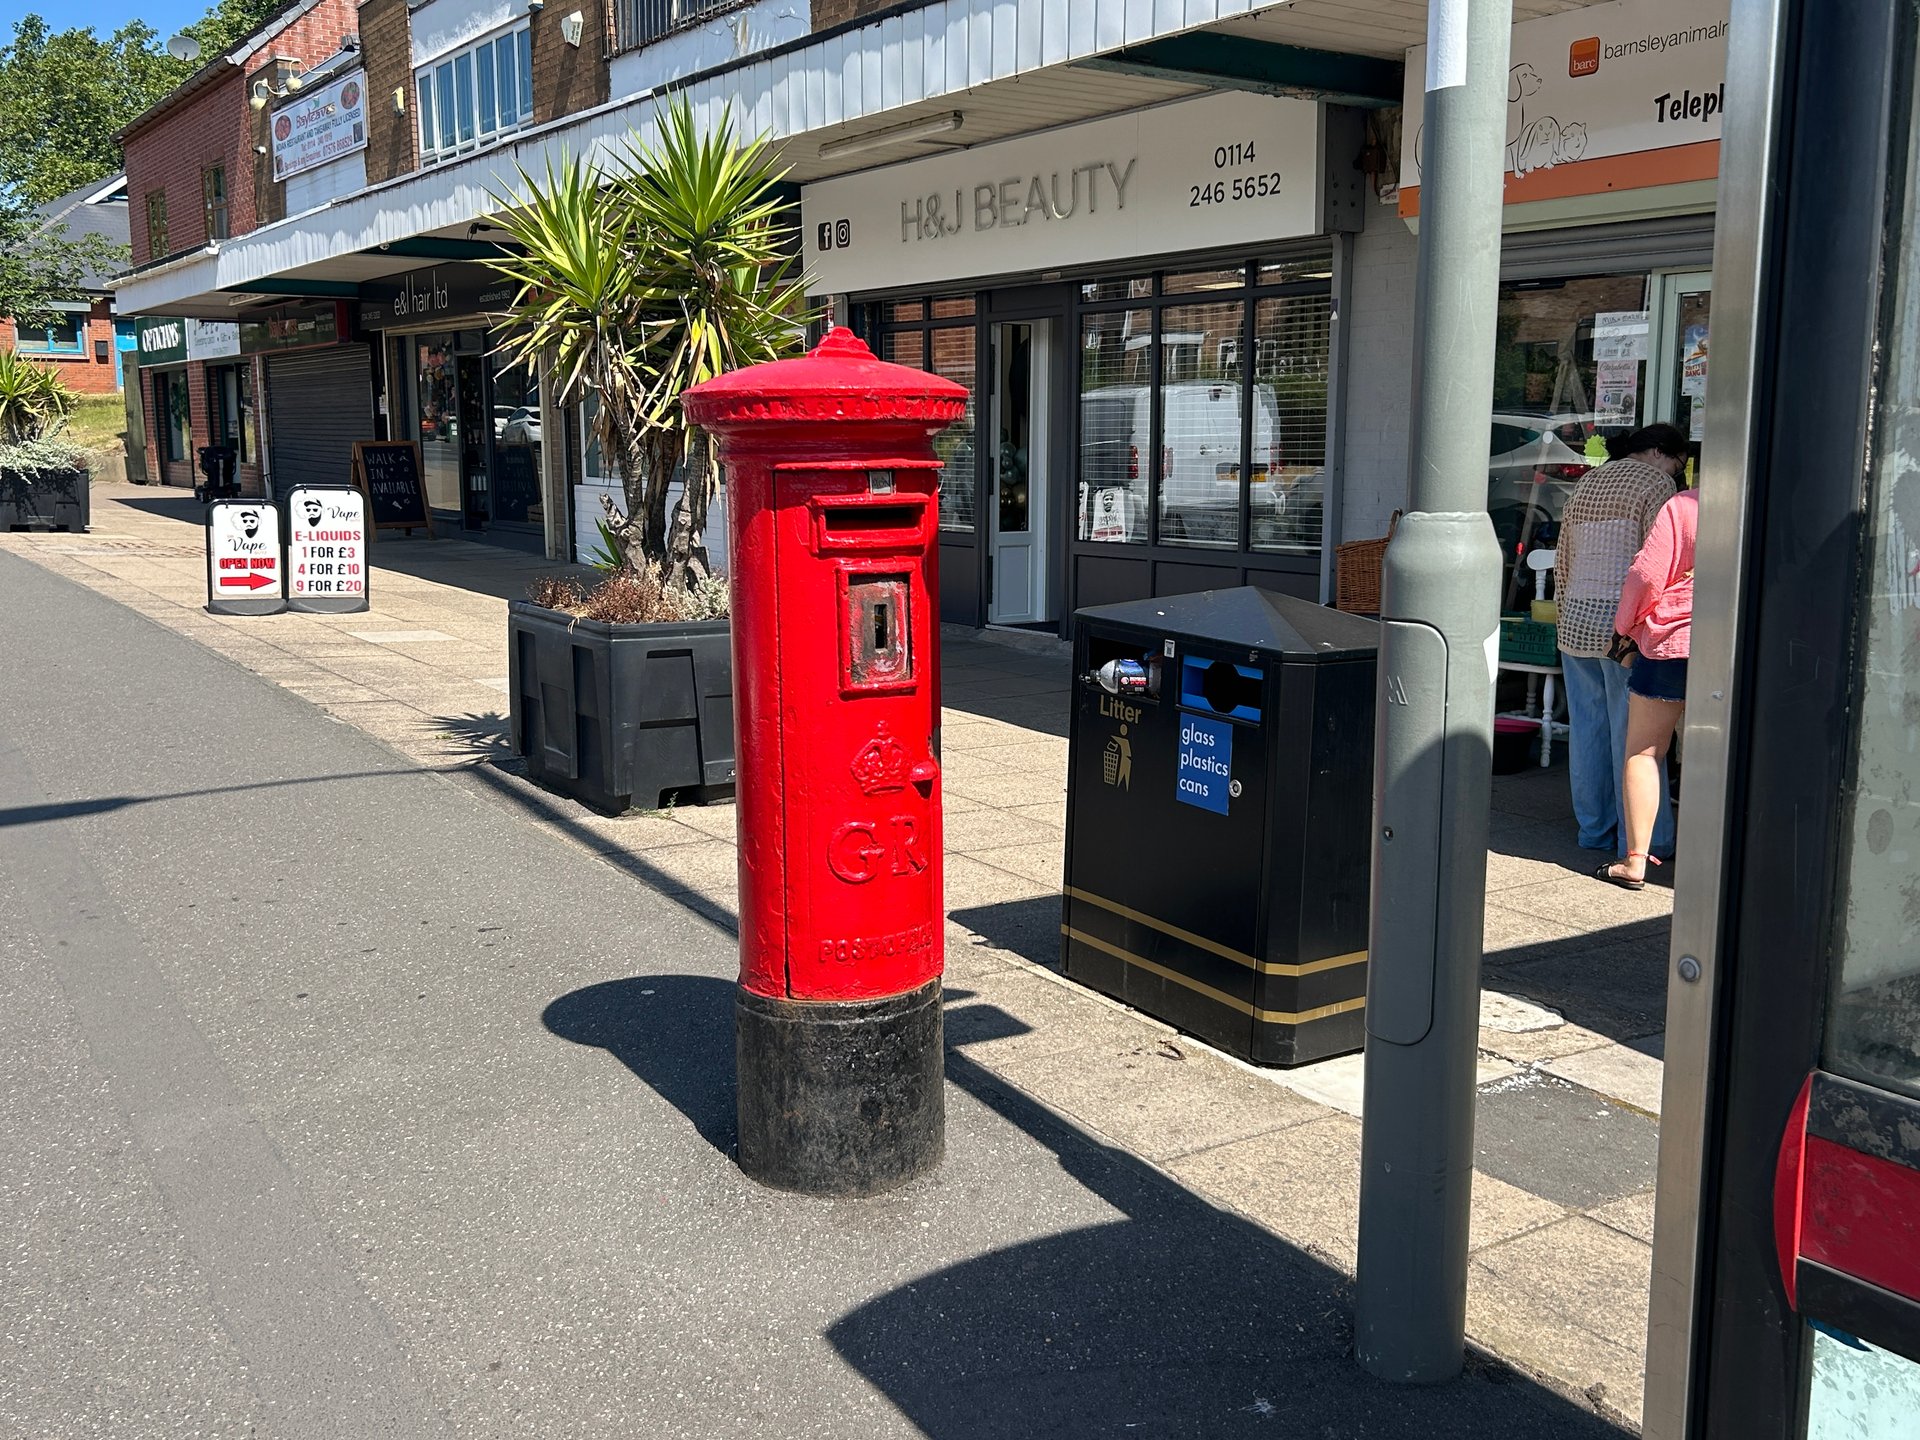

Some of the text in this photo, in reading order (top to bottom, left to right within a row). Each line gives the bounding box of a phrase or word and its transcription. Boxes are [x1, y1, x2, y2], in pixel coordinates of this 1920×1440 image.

[1573, 57, 1596, 71] barc
[287, 131, 307, 147] RESTAURANT
[314, 122, 332, 137] TAKEAWAY
[343, 108, 361, 124] LICENSED
[1214, 140, 1256, 169] 0114
[1190, 172, 1281, 208] 246 5652
[900, 158, 1137, 243] H&J BEAUTY
[411, 274, 431, 313] hair
[433, 269, 448, 310] ltd
[142, 322, 179, 352] OPTICIANS
[365, 452, 396, 465] WALK
[370, 468, 385, 480] IN
[372, 480, 417, 495] AVAILABLE
[327, 506, 360, 521] Vape
[295, 531, 361, 542] E-LIQUIDS
[228, 537, 267, 554] Vape
[302, 547, 355, 558] 1 FOR £3
[219, 558, 276, 569] OPEN NOW
[298, 564, 360, 575] 4 FOR £10
[296, 580, 362, 592] 9 FOR £20
[1100, 694, 1141, 724] Litter
[1181, 723, 1215, 747] glass
[1180, 748, 1229, 777] plastics
[1179, 778, 1209, 797] cans
